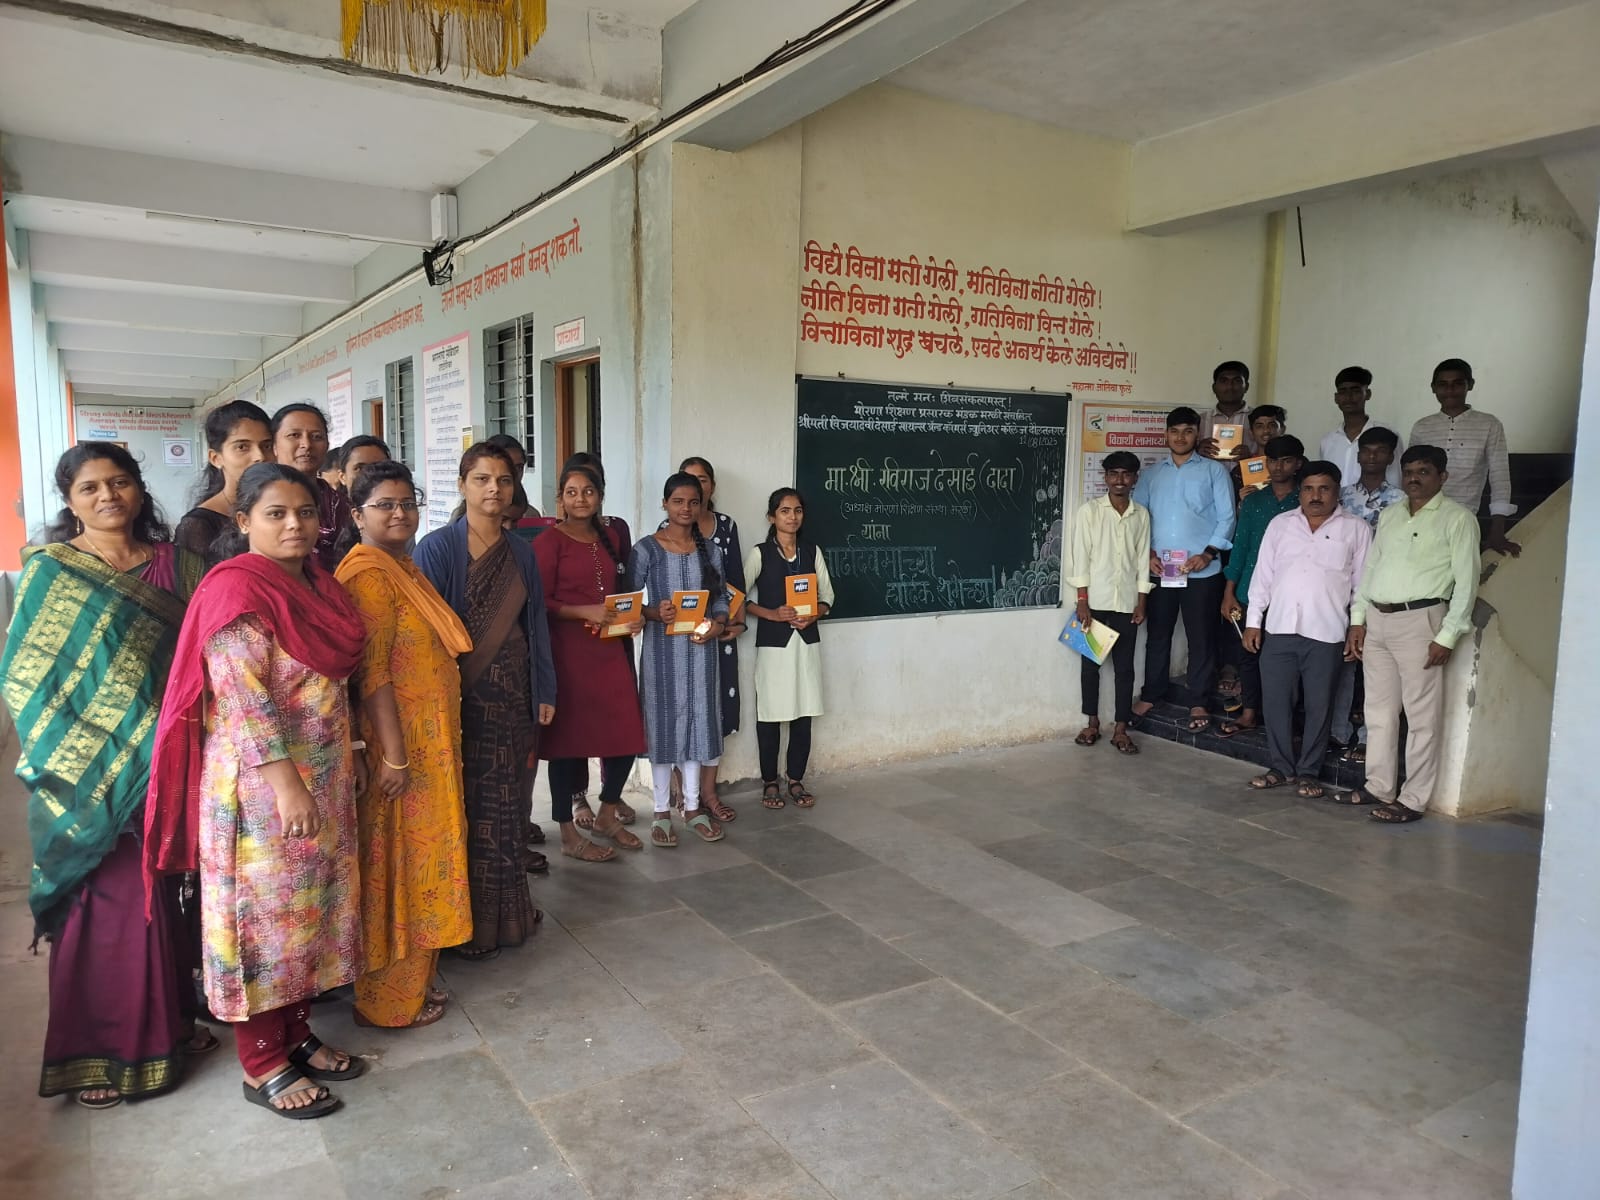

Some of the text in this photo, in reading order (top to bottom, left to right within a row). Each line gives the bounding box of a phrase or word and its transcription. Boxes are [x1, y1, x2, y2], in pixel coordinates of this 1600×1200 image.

[845, 245, 886, 281] विना
[888, 255, 922, 286] मती
[967, 266, 1031, 300] मतिविना
[1031, 274, 1065, 305] नीती
[801, 279, 846, 312] नीति
[848, 284, 891, 316] विना
[893, 292, 926, 320] गती
[971, 302, 1035, 332] गतिविना
[1037, 309, 1068, 335] वित्त
[971, 331, 1003, 359] एवढे
[1003, 336, 1045, 363] अनर्थ
[1046, 338, 1073, 366] केले
[862, 519, 892, 540] यांना
